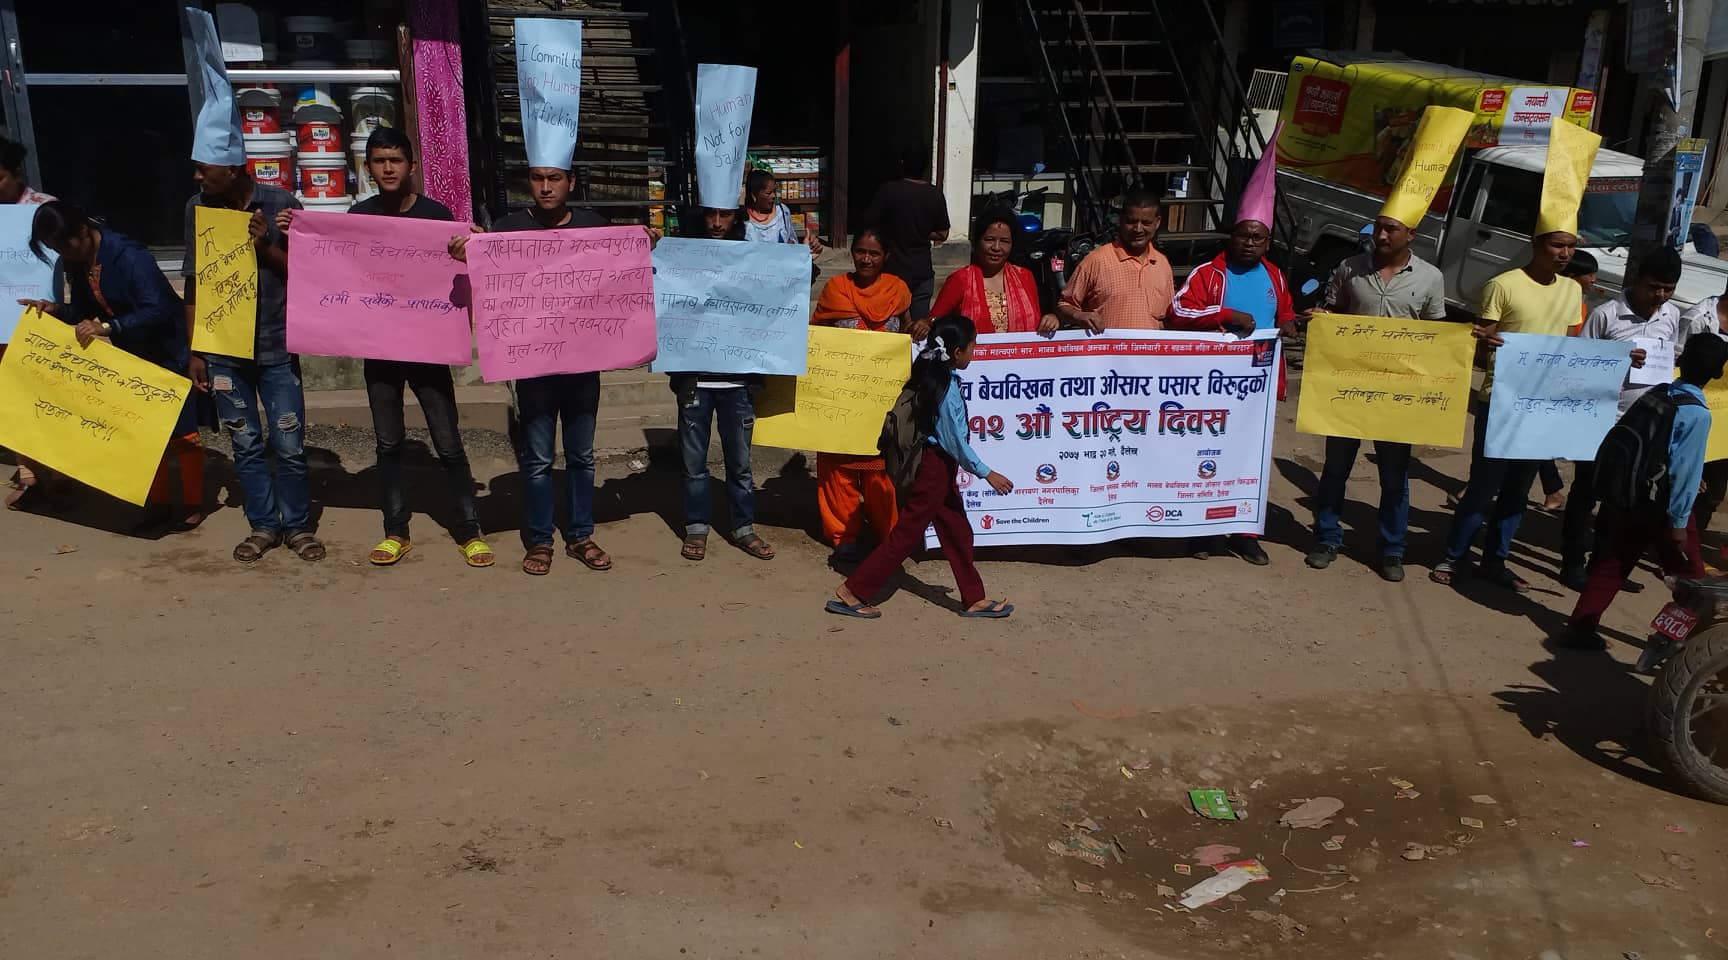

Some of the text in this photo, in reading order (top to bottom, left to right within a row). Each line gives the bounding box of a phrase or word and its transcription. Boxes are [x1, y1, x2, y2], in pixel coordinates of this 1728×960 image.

[531, 43, 569, 67] Commit
[703, 122, 747, 152] Not for
[960, 379, 972, 400] व
[1060, 375, 1096, 398] तथा
[1100, 369, 1154, 397] ओसार
[1158, 375, 1204, 397] पसार
[1062, 401, 1152, 443] राष्ट्रिय
[1158, 400, 1231, 438] दिवस
[1022, 516, 1050, 524] Children
[1165, 509, 1183, 518] DCA
